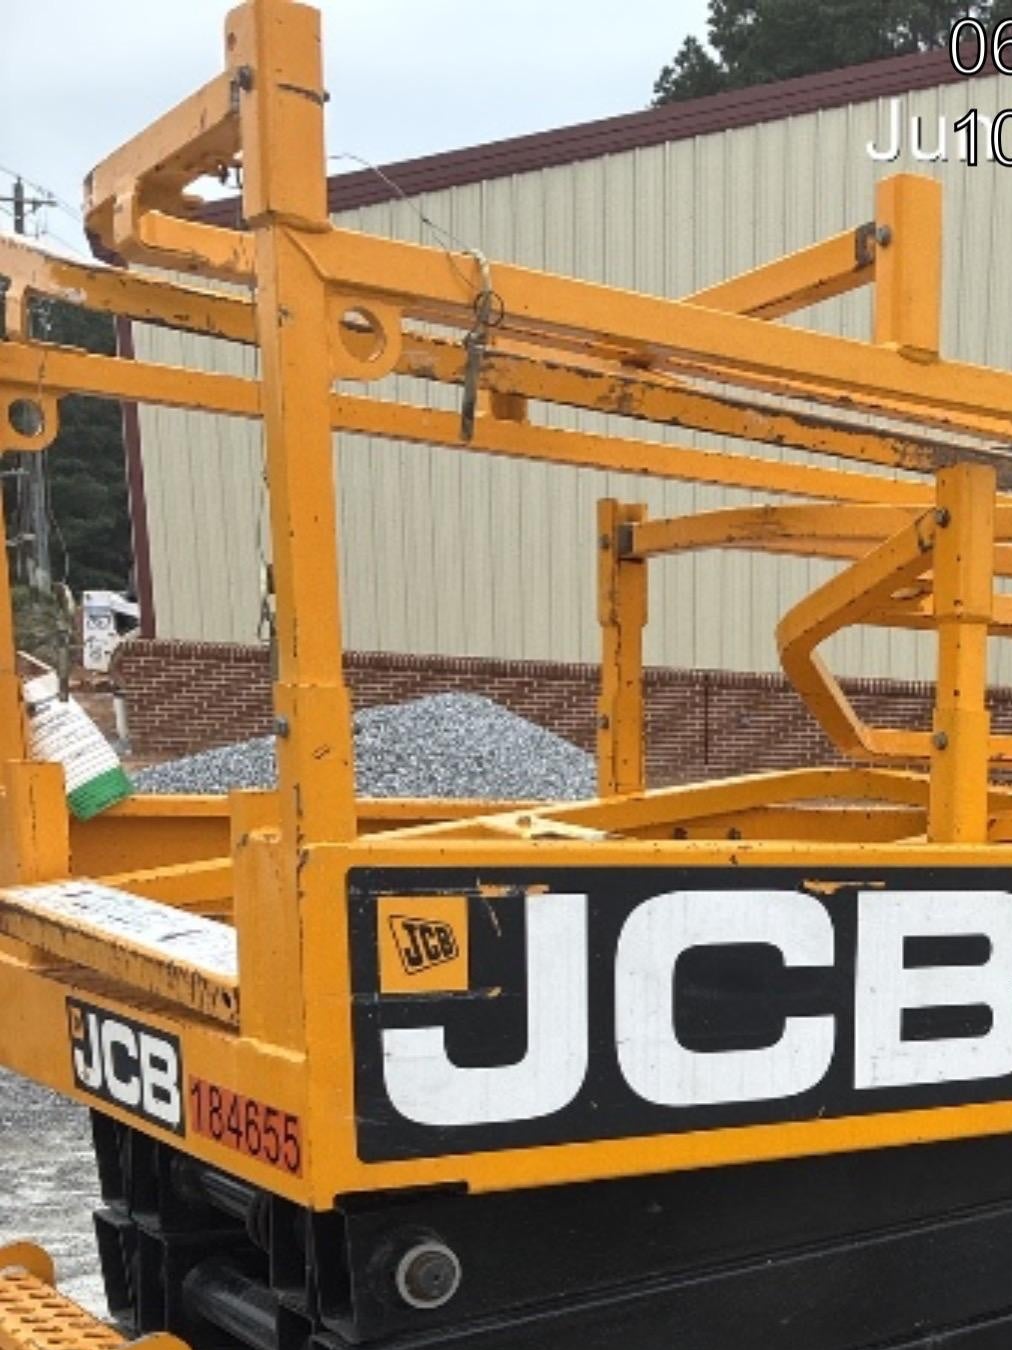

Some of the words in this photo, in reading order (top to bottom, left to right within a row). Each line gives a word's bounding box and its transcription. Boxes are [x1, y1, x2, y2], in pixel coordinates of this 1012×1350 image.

[401, 921, 454, 967] JCB
[74, 1013, 181, 1124] JCB
[191, 1081, 300, 1173] 184655
